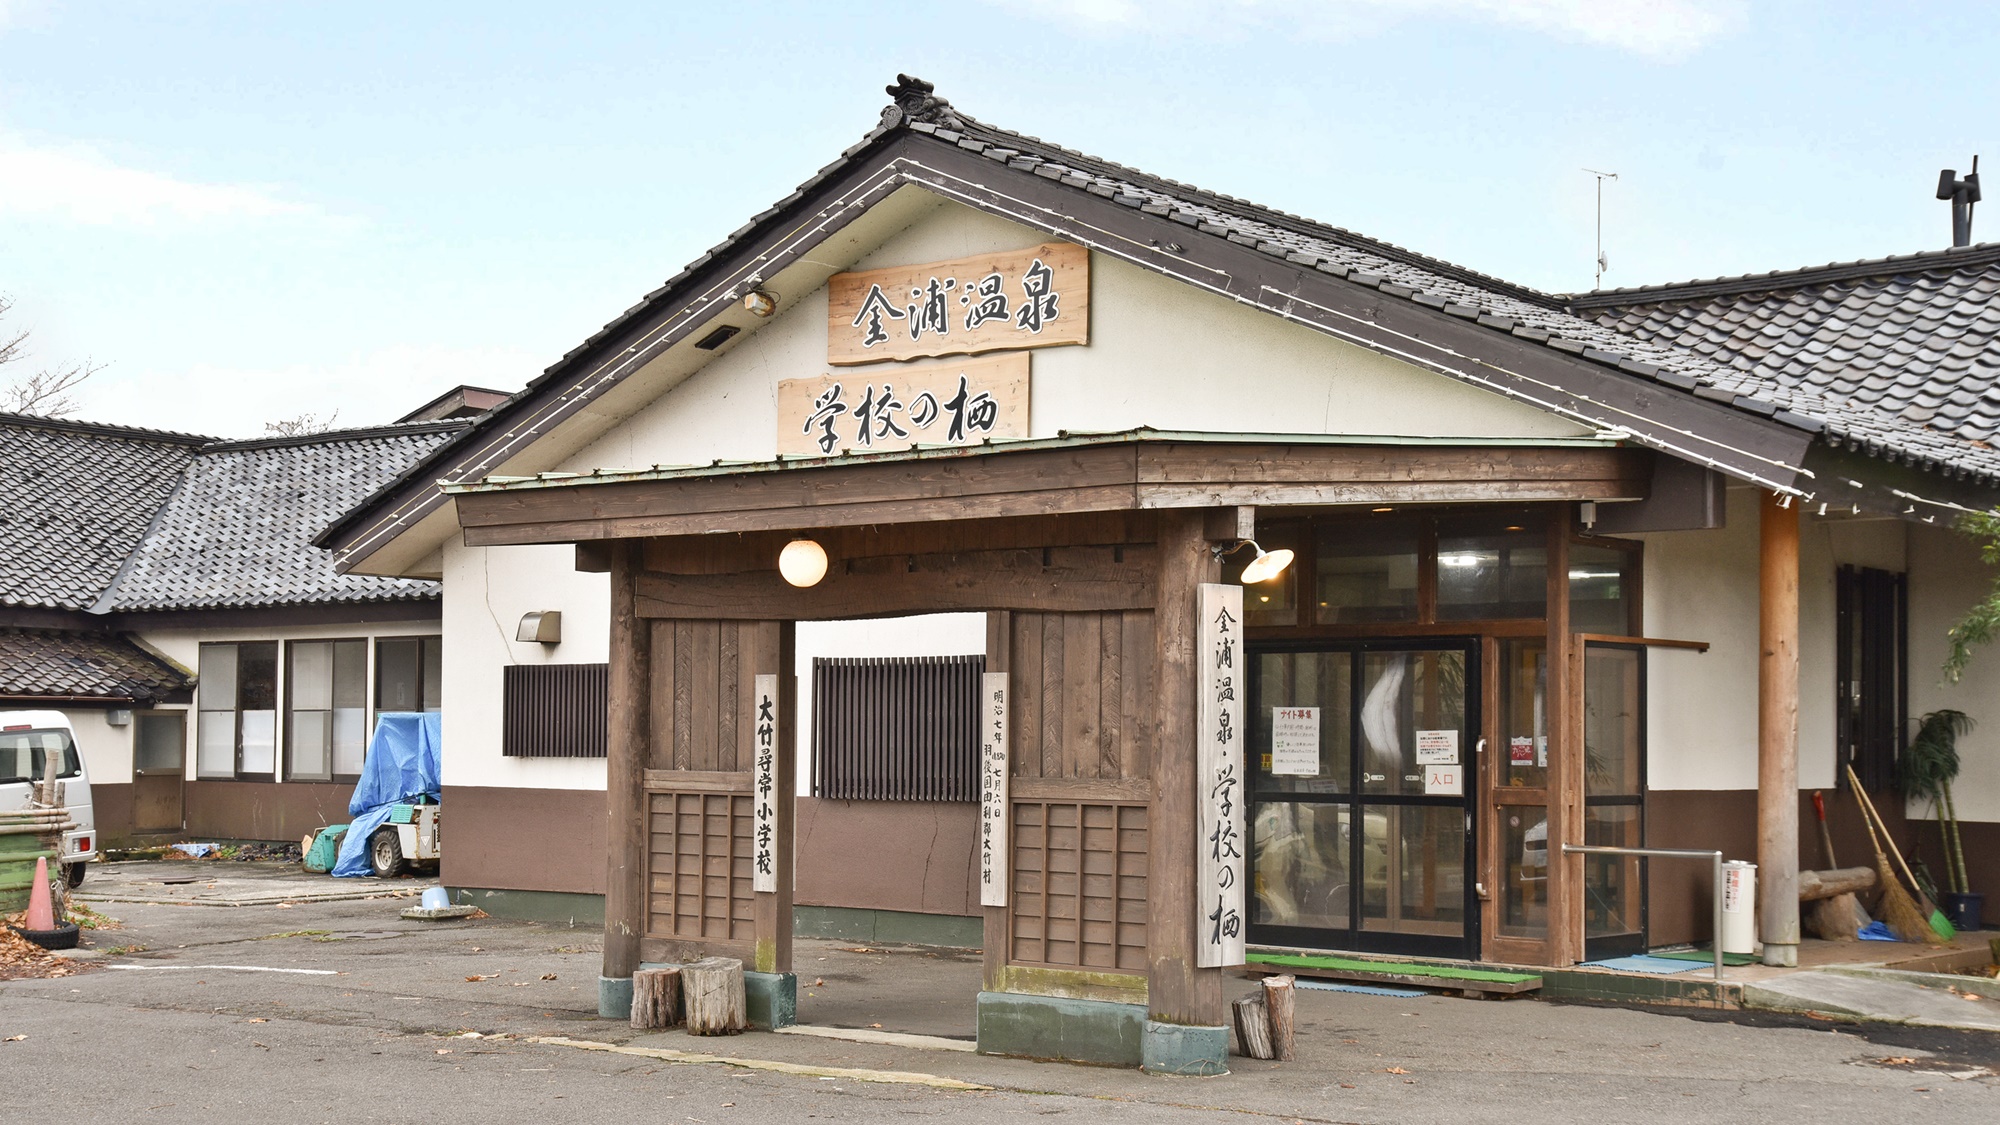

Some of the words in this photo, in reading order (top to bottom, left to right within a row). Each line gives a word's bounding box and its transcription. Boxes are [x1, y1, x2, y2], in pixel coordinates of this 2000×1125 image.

[852, 258, 1059, 347] 金浦温泉
[803, 374, 1000, 454] 学校の栖
[756, 695, 774, 876] 大竹尋常小学校
[1430, 773, 1454, 785] 入口
